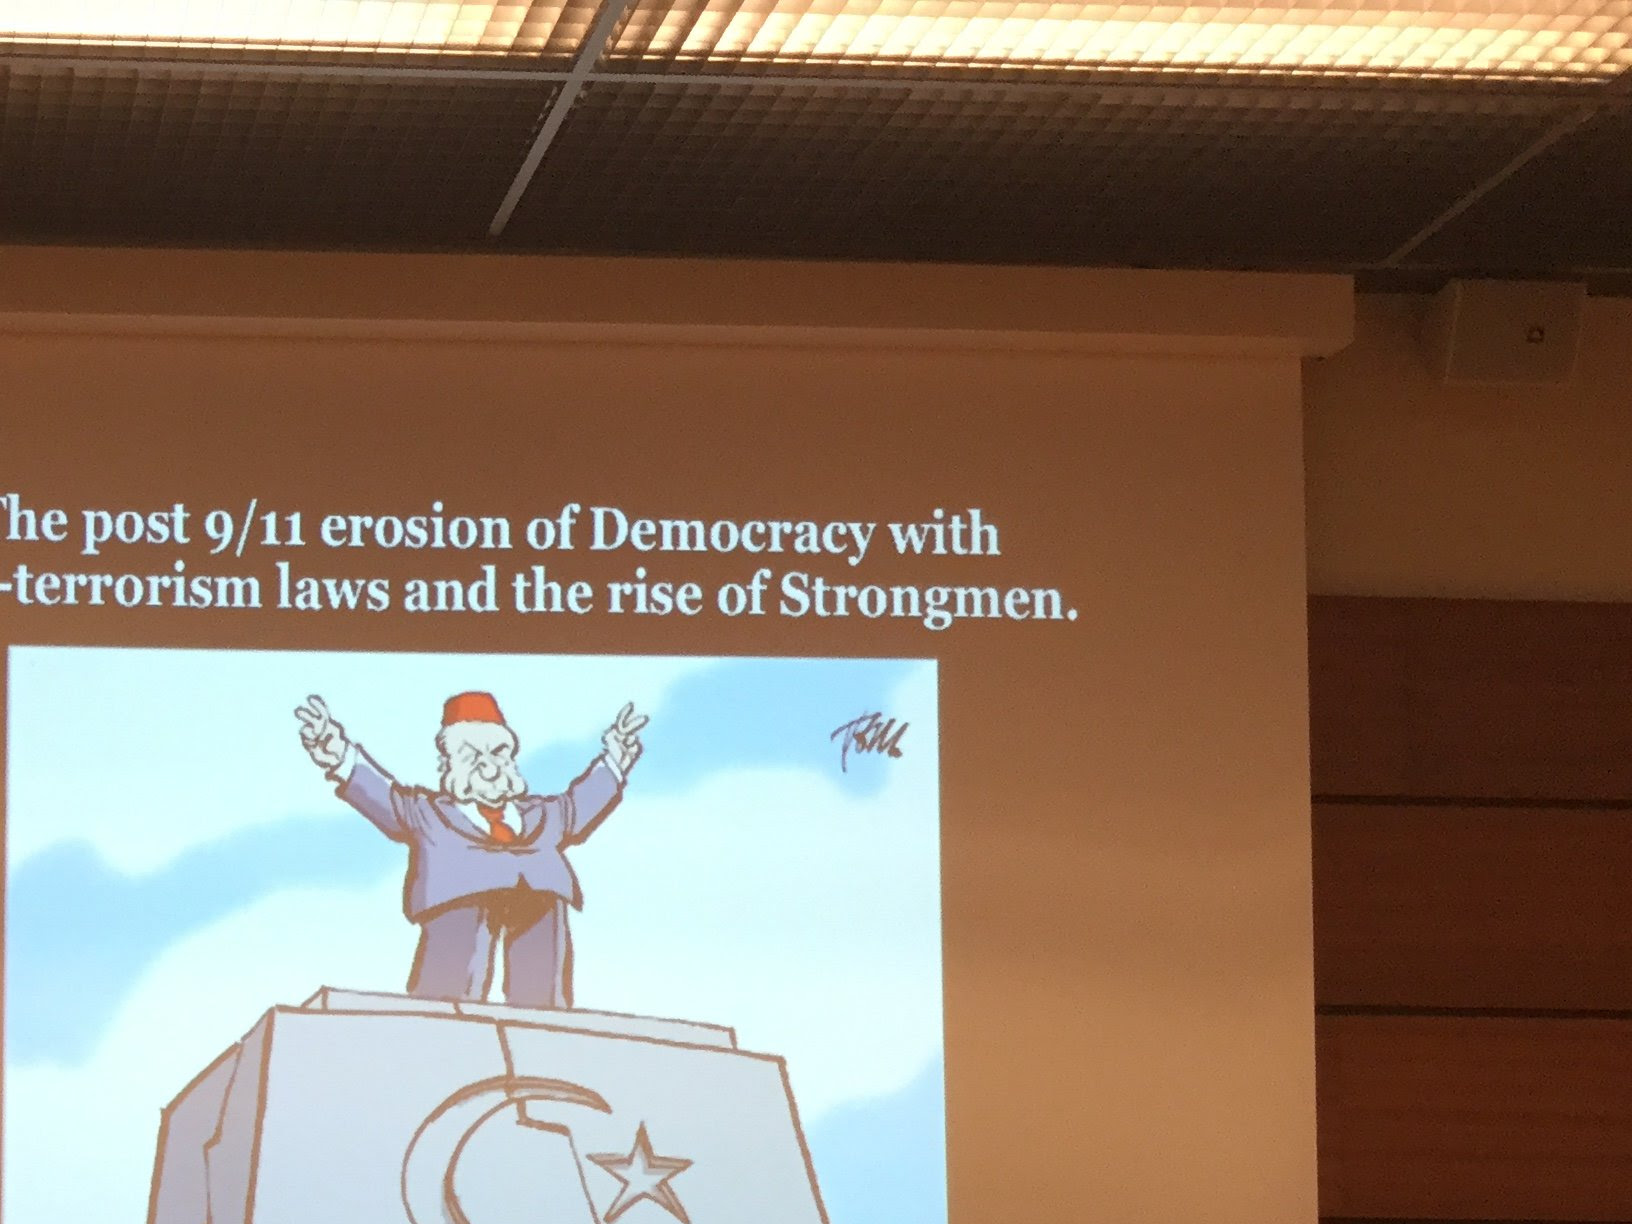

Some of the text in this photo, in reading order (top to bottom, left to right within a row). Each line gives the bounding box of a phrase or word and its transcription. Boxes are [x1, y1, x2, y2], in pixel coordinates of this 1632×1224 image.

[81, 504, 190, 554] post
[205, 499, 306, 556] 9/11
[321, 502, 513, 549] erosion
[527, 503, 580, 549] of
[589, 507, 876, 566] Democracy
[887, 509, 1000, 555] with
[276, 562, 389, 611] laws
[405, 565, 499, 612] and
[512, 566, 593, 614] the
[607, 567, 702, 615] rise
[718, 569, 771, 616] of
[780, 572, 1077, 630] Strongmen.
